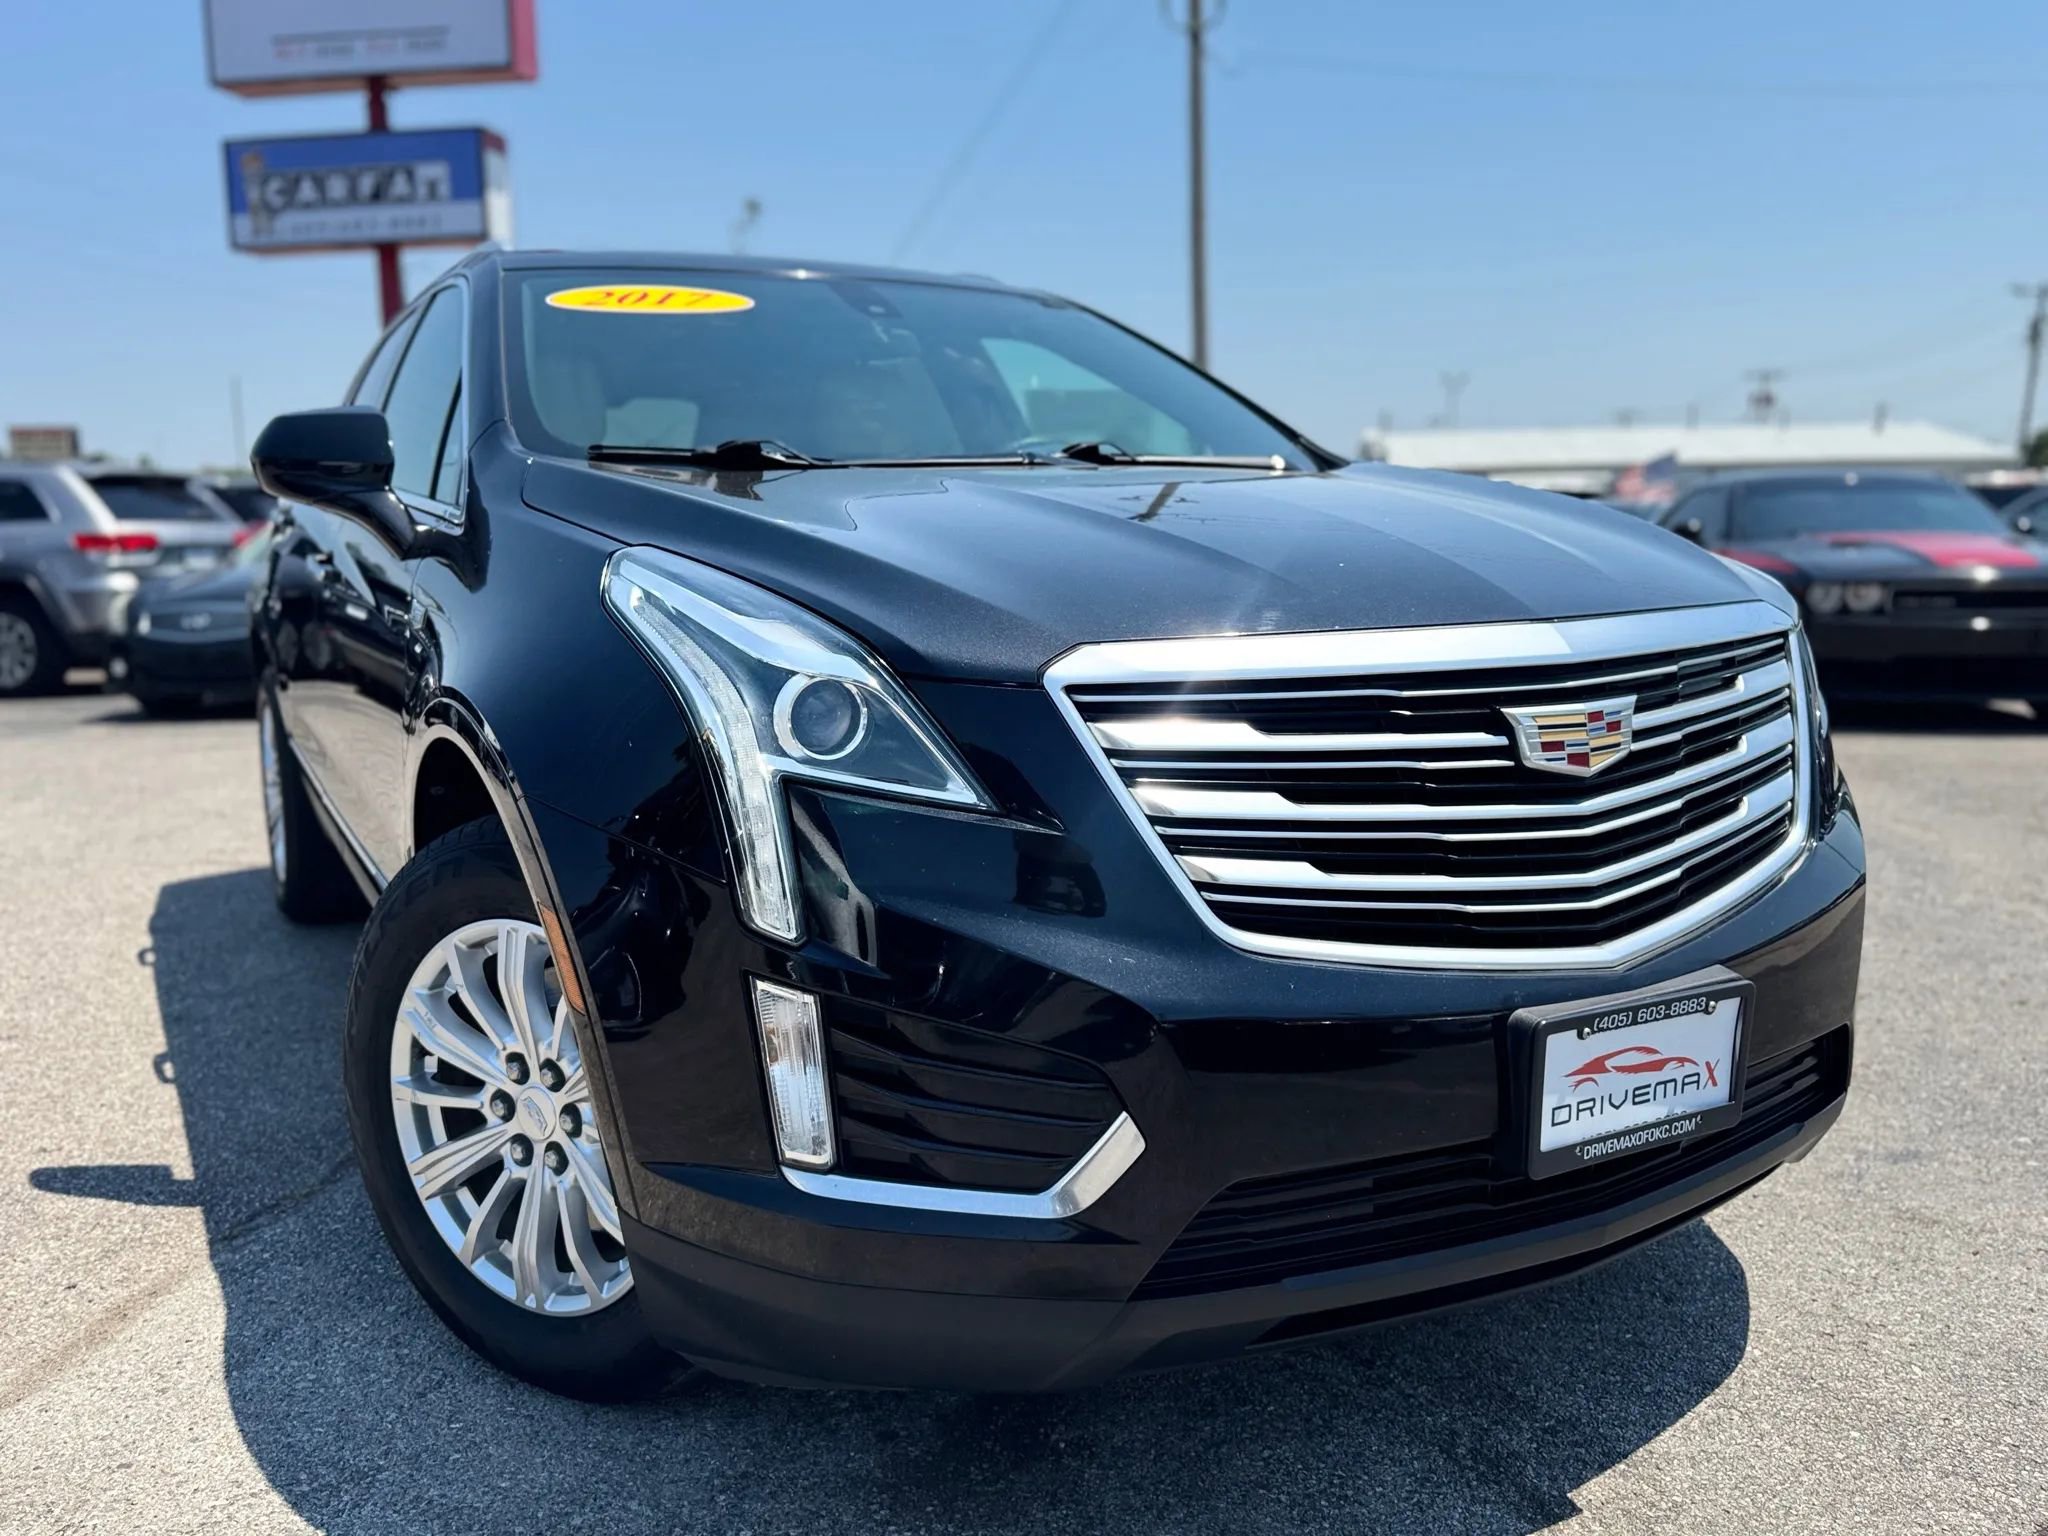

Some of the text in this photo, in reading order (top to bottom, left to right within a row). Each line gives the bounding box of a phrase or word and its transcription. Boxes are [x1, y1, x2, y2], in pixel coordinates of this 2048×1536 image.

[582, 290, 715, 306] 2017
[1593, 997, 1707, 1032] (405) 603-8883
[1550, 1058, 1720, 1128] DRIVEMAX
[1583, 1117, 1697, 1161] DRIVEMAXOFOKC.COM
